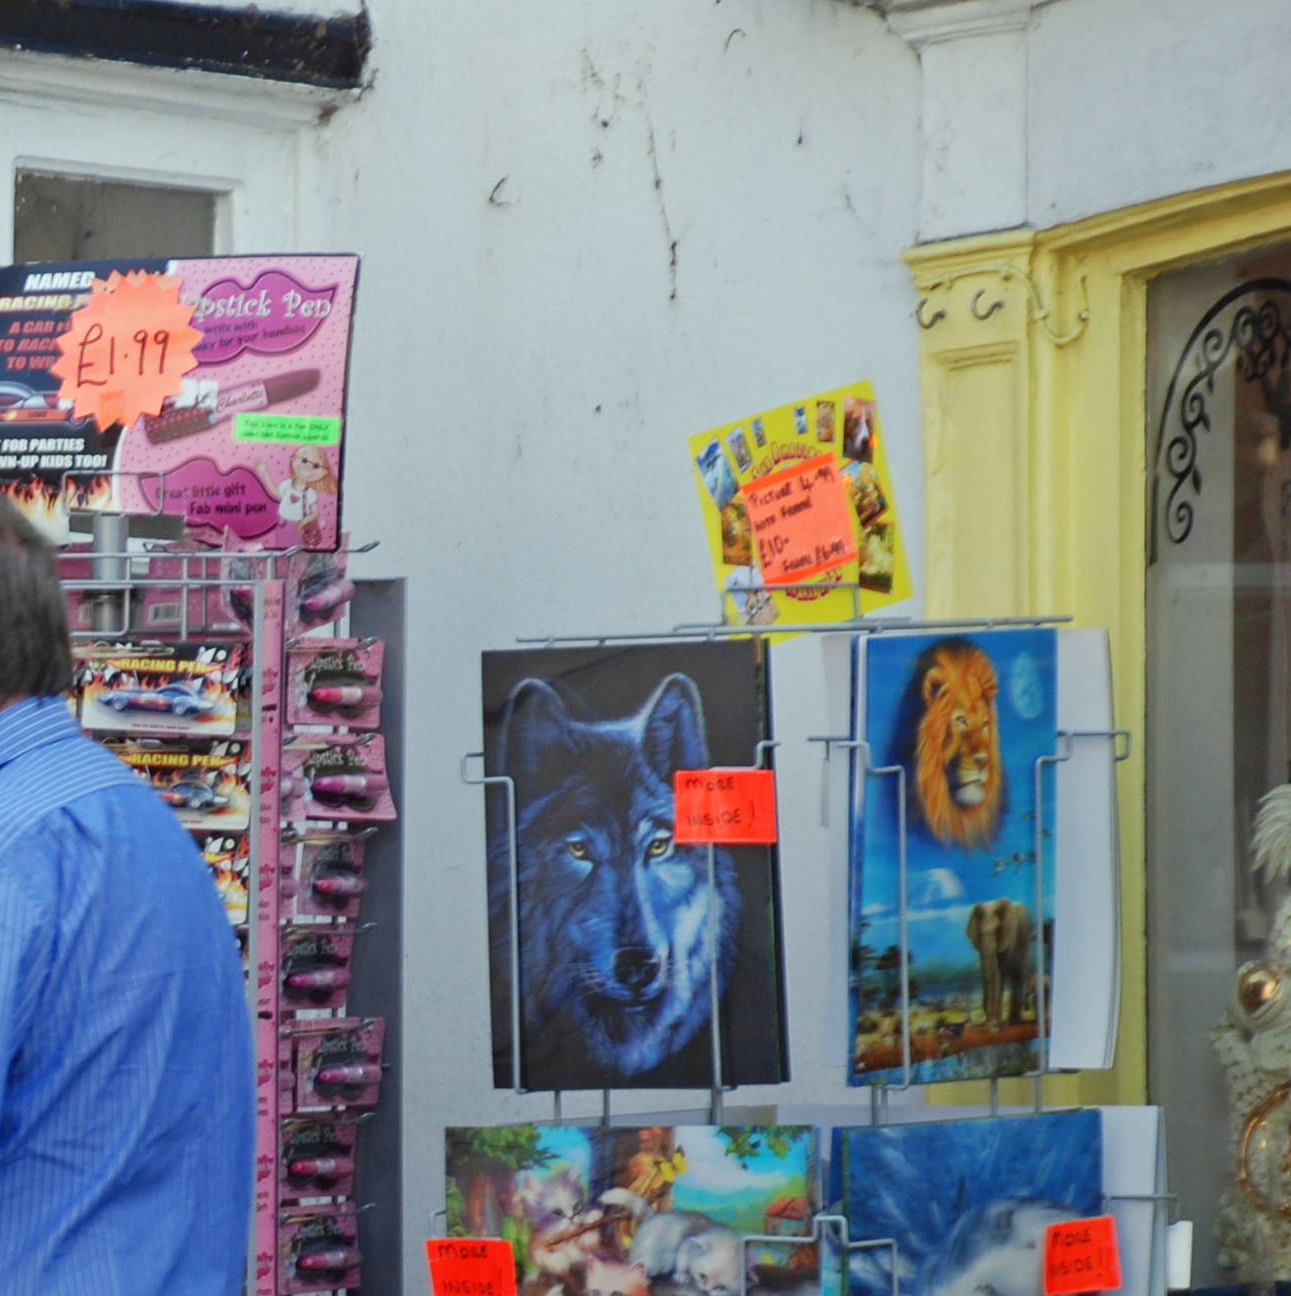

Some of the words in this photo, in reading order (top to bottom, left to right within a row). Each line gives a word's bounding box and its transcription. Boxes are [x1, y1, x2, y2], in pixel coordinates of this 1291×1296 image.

[23, 271, 95, 292] NAMED
[283, 288, 332, 318] Pen
[8, 321, 21, 335] A
[22, 320, 55, 335] CAR
[234, 320, 258, 331] with
[237, 332, 259, 346] your
[263, 323, 306, 339] handbag
[76, 322, 171, 388] £1.99
[7, 356, 26, 370] TO
[216, 388, 265, 413] Charlotte
[2, 439, 28, 452] FOR
[28, 438, 85, 452] PARTIES
[39, 455, 73, 469] KIDS
[75, 454, 107, 468] TOO!
[156, 484, 188, 499] Great
[192, 483, 221, 497] little
[224, 483, 247, 499] gift
[190, 502, 211, 514] Fab
[215, 501, 242, 514] mini
[245, 503, 268, 516] pen
[121, 657, 176, 671] RACING
[177, 659, 208, 673] PEN
[131, 753, 189, 766] RACING
[192, 754, 222, 767] PEN
